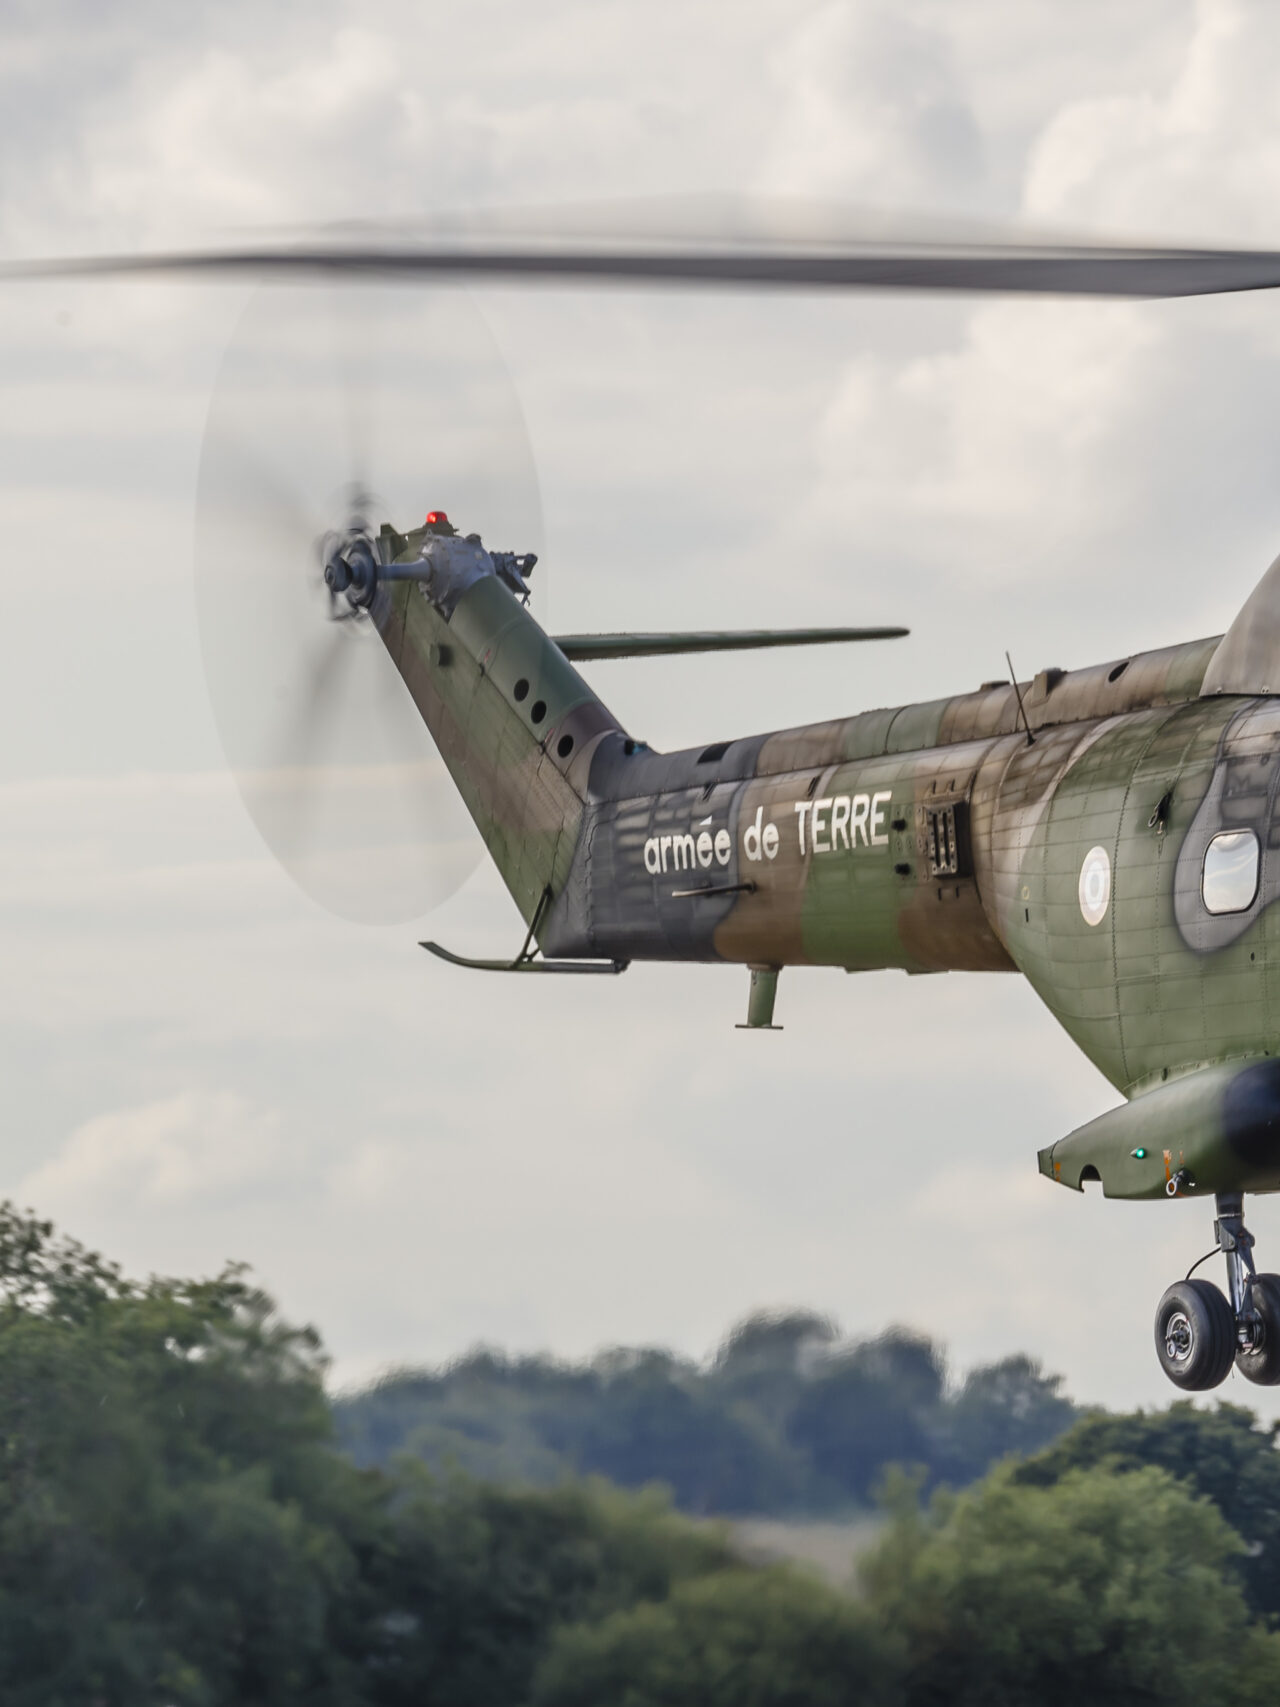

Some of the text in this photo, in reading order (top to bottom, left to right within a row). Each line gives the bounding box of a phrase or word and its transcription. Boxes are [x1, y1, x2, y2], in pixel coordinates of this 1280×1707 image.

[644, 791, 892, 874] armée de TERRE
